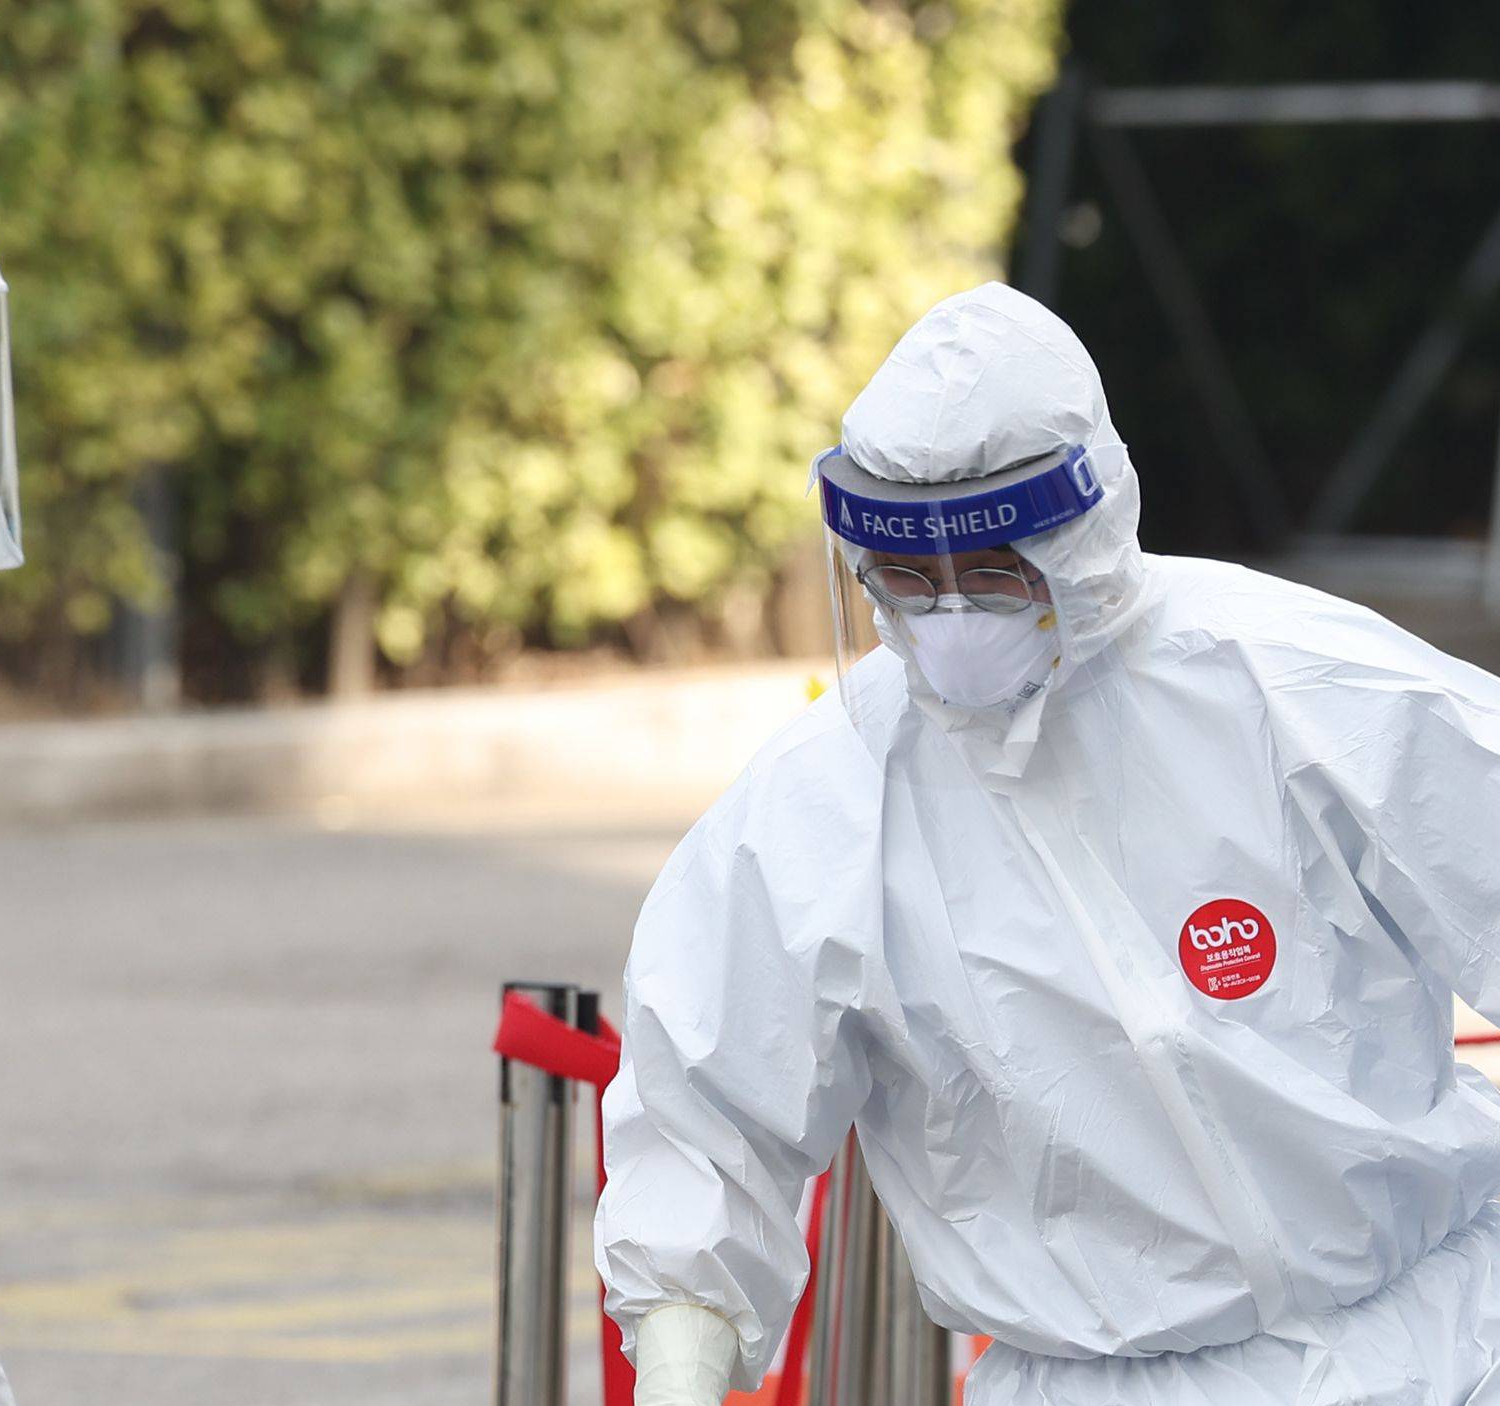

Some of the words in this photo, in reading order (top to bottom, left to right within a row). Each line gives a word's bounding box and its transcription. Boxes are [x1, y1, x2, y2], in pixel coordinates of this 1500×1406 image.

[861, 511, 918, 539] FACE
[923, 503, 1017, 539] SHIELD
[1188, 917, 1259, 950] boho
